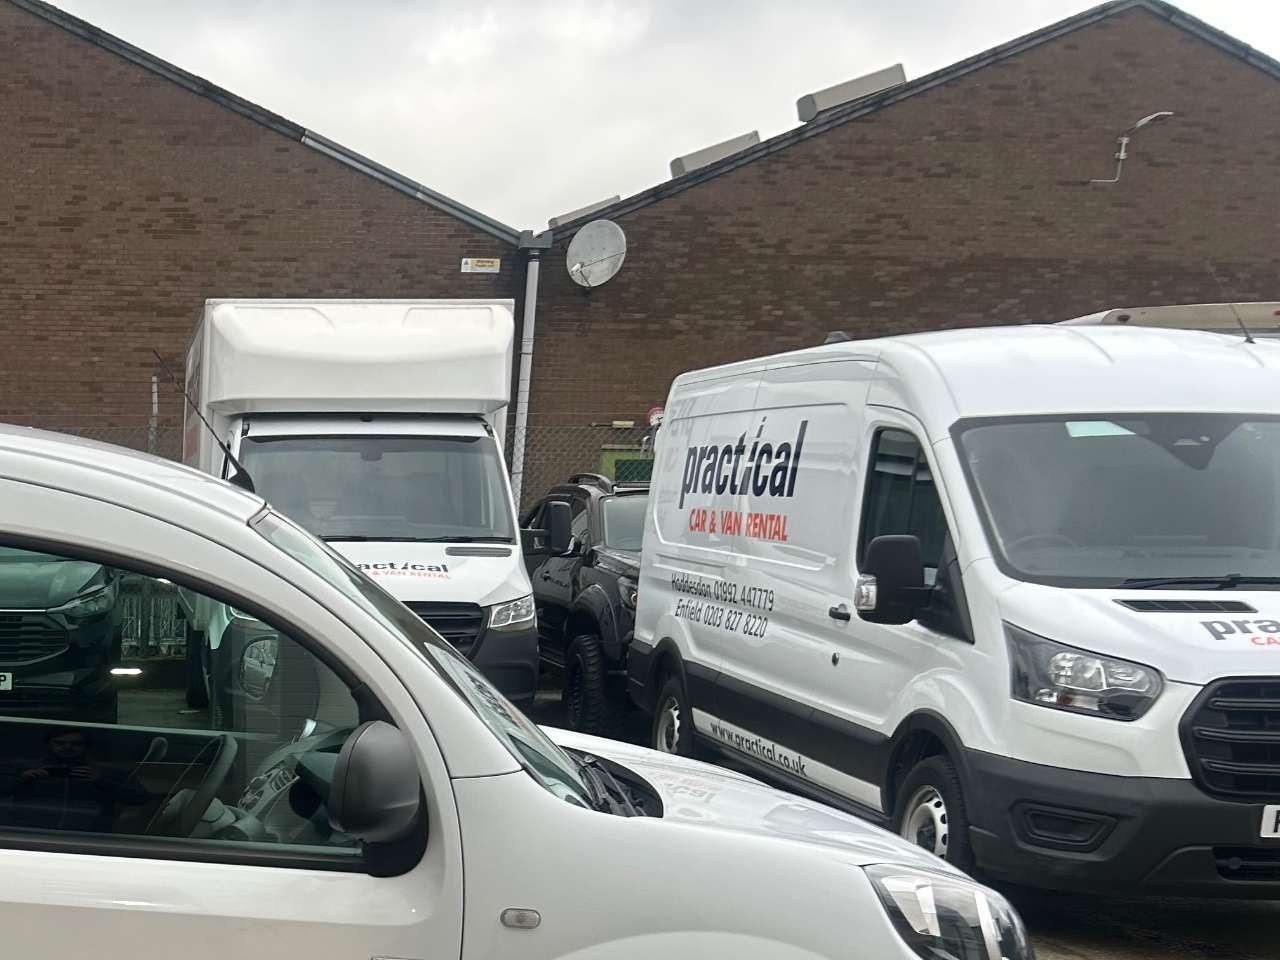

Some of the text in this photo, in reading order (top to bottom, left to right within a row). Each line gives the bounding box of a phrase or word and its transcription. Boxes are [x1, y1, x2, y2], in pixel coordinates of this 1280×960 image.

[679, 416, 809, 510] practical
[688, 508, 788, 542] CAR & VAN RENTAL
[671, 572, 774, 611] Hoddesdon 01992 447779
[674, 598, 768, 638] Enfield 0203 827 8220
[710, 722, 807, 777] www.practical.co.uk
